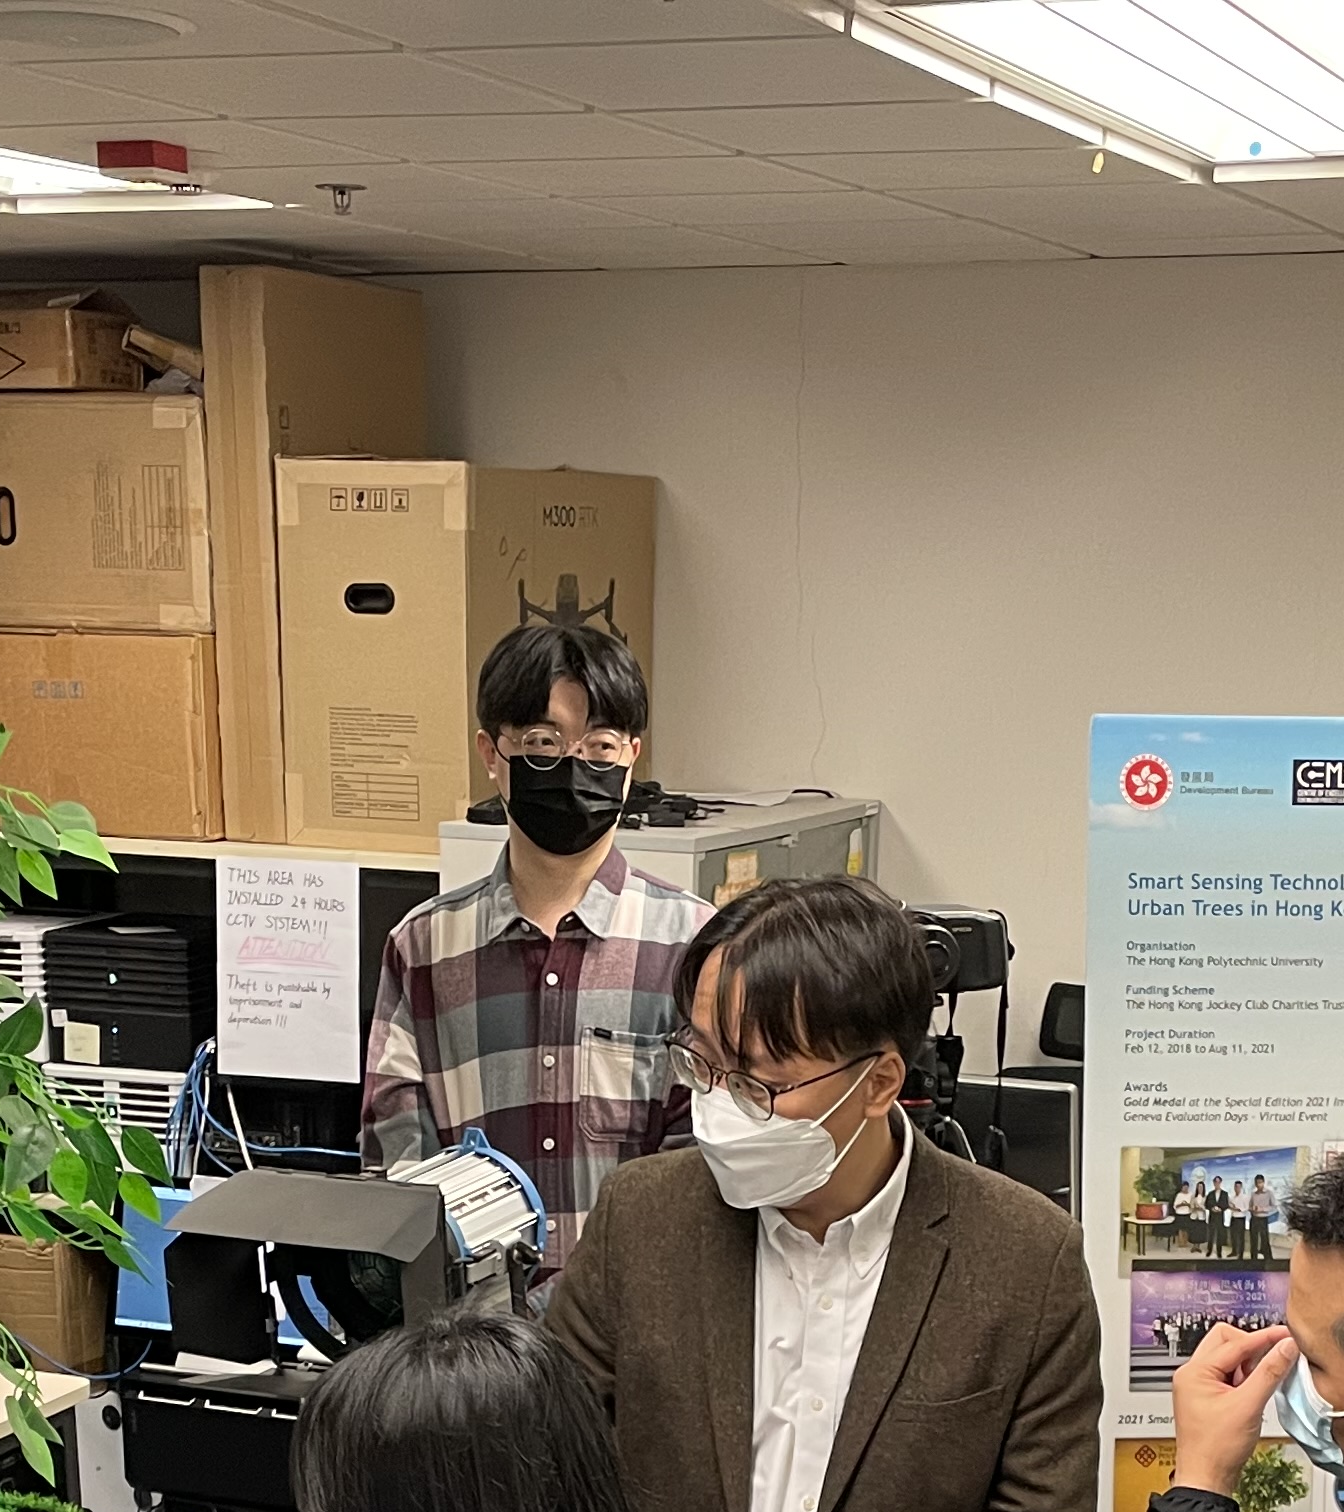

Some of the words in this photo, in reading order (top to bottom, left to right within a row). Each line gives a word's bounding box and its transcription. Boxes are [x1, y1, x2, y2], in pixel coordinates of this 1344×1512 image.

[543, 505, 576, 527] M300
[1179, 786, 1239, 797] Development
[227, 867, 260, 884] THIS
[267, 870, 294, 885] AREA
[303, 873, 324, 888] HAS
[1128, 872, 1184, 891] Smart
[1191, 872, 1263, 894] Sensing
[227, 890, 284, 906] INSTALLED
[291, 896, 307, 909] 24
[313, 897, 346, 912] HOURS
[1128, 899, 1185, 917] Urban
[1192, 899, 1244, 917] Trees
[1251, 899, 1268, 917] in
[1275, 900, 1324, 920] Hong
[226, 912, 256, 927] CCTV
[238, 936, 331, 961] ATTENTION
[1126, 941, 1196, 954] Organisation
[1126, 956, 1146, 967] The
[1149, 956, 1176, 968] Hong
[1178, 956, 1204, 968] Kong
[1207, 956, 1268, 968] Polytechnic
[1270, 956, 1324, 968] University
[226, 973, 257, 993] Theft
[264, 980, 273, 992] is
[321, 982, 331, 999] by
[1125, 985, 1170, 997] Funding
[1172, 985, 1215, 996] Scheme
[288, 1000, 302, 1010] and
[1126, 1000, 1146, 1011] The
[1148, 1000, 1175, 1012] Hong
[1177, 1000, 1203, 1012] Kong
[1206, 1000, 1243, 1012] Jockey
[1245, 1000, 1269, 1011] Club
[1271, 1000, 1319, 1011] Charities
[1125, 1029, 1165, 1042] Project
[1168, 1029, 1216, 1040] Duration
[1124, 1043, 1144, 1054] Feb
[1167, 1043, 1192, 1054] 2018
[1194, 1044, 1207, 1054] to
[1208, 1043, 1228, 1055] Aug
[1251, 1043, 1276, 1054] 2021
[1124, 1082, 1168, 1093] Awards
[1124, 1096, 1150, 1107] Gold
[1152, 1096, 1187, 1107] Medal
[1188, 1097, 1201, 1107] at
[1203, 1096, 1222, 1107] the
[1224, 1096, 1262, 1109] Special
[1264, 1096, 1303, 1107] Edition
[1305, 1096, 1330, 1107] 2021
[1123, 1111, 1162, 1122] Geneva
[1165, 1111, 1222, 1122] Evaluation
[1224, 1111, 1249, 1123] Days
[1259, 1111, 1296, 1122] Virtual
[1298, 1111, 1328, 1122] Event
[1117, 1414, 1144, 1425] 2021
[1147, 1414, 1176, 1425] Smar
